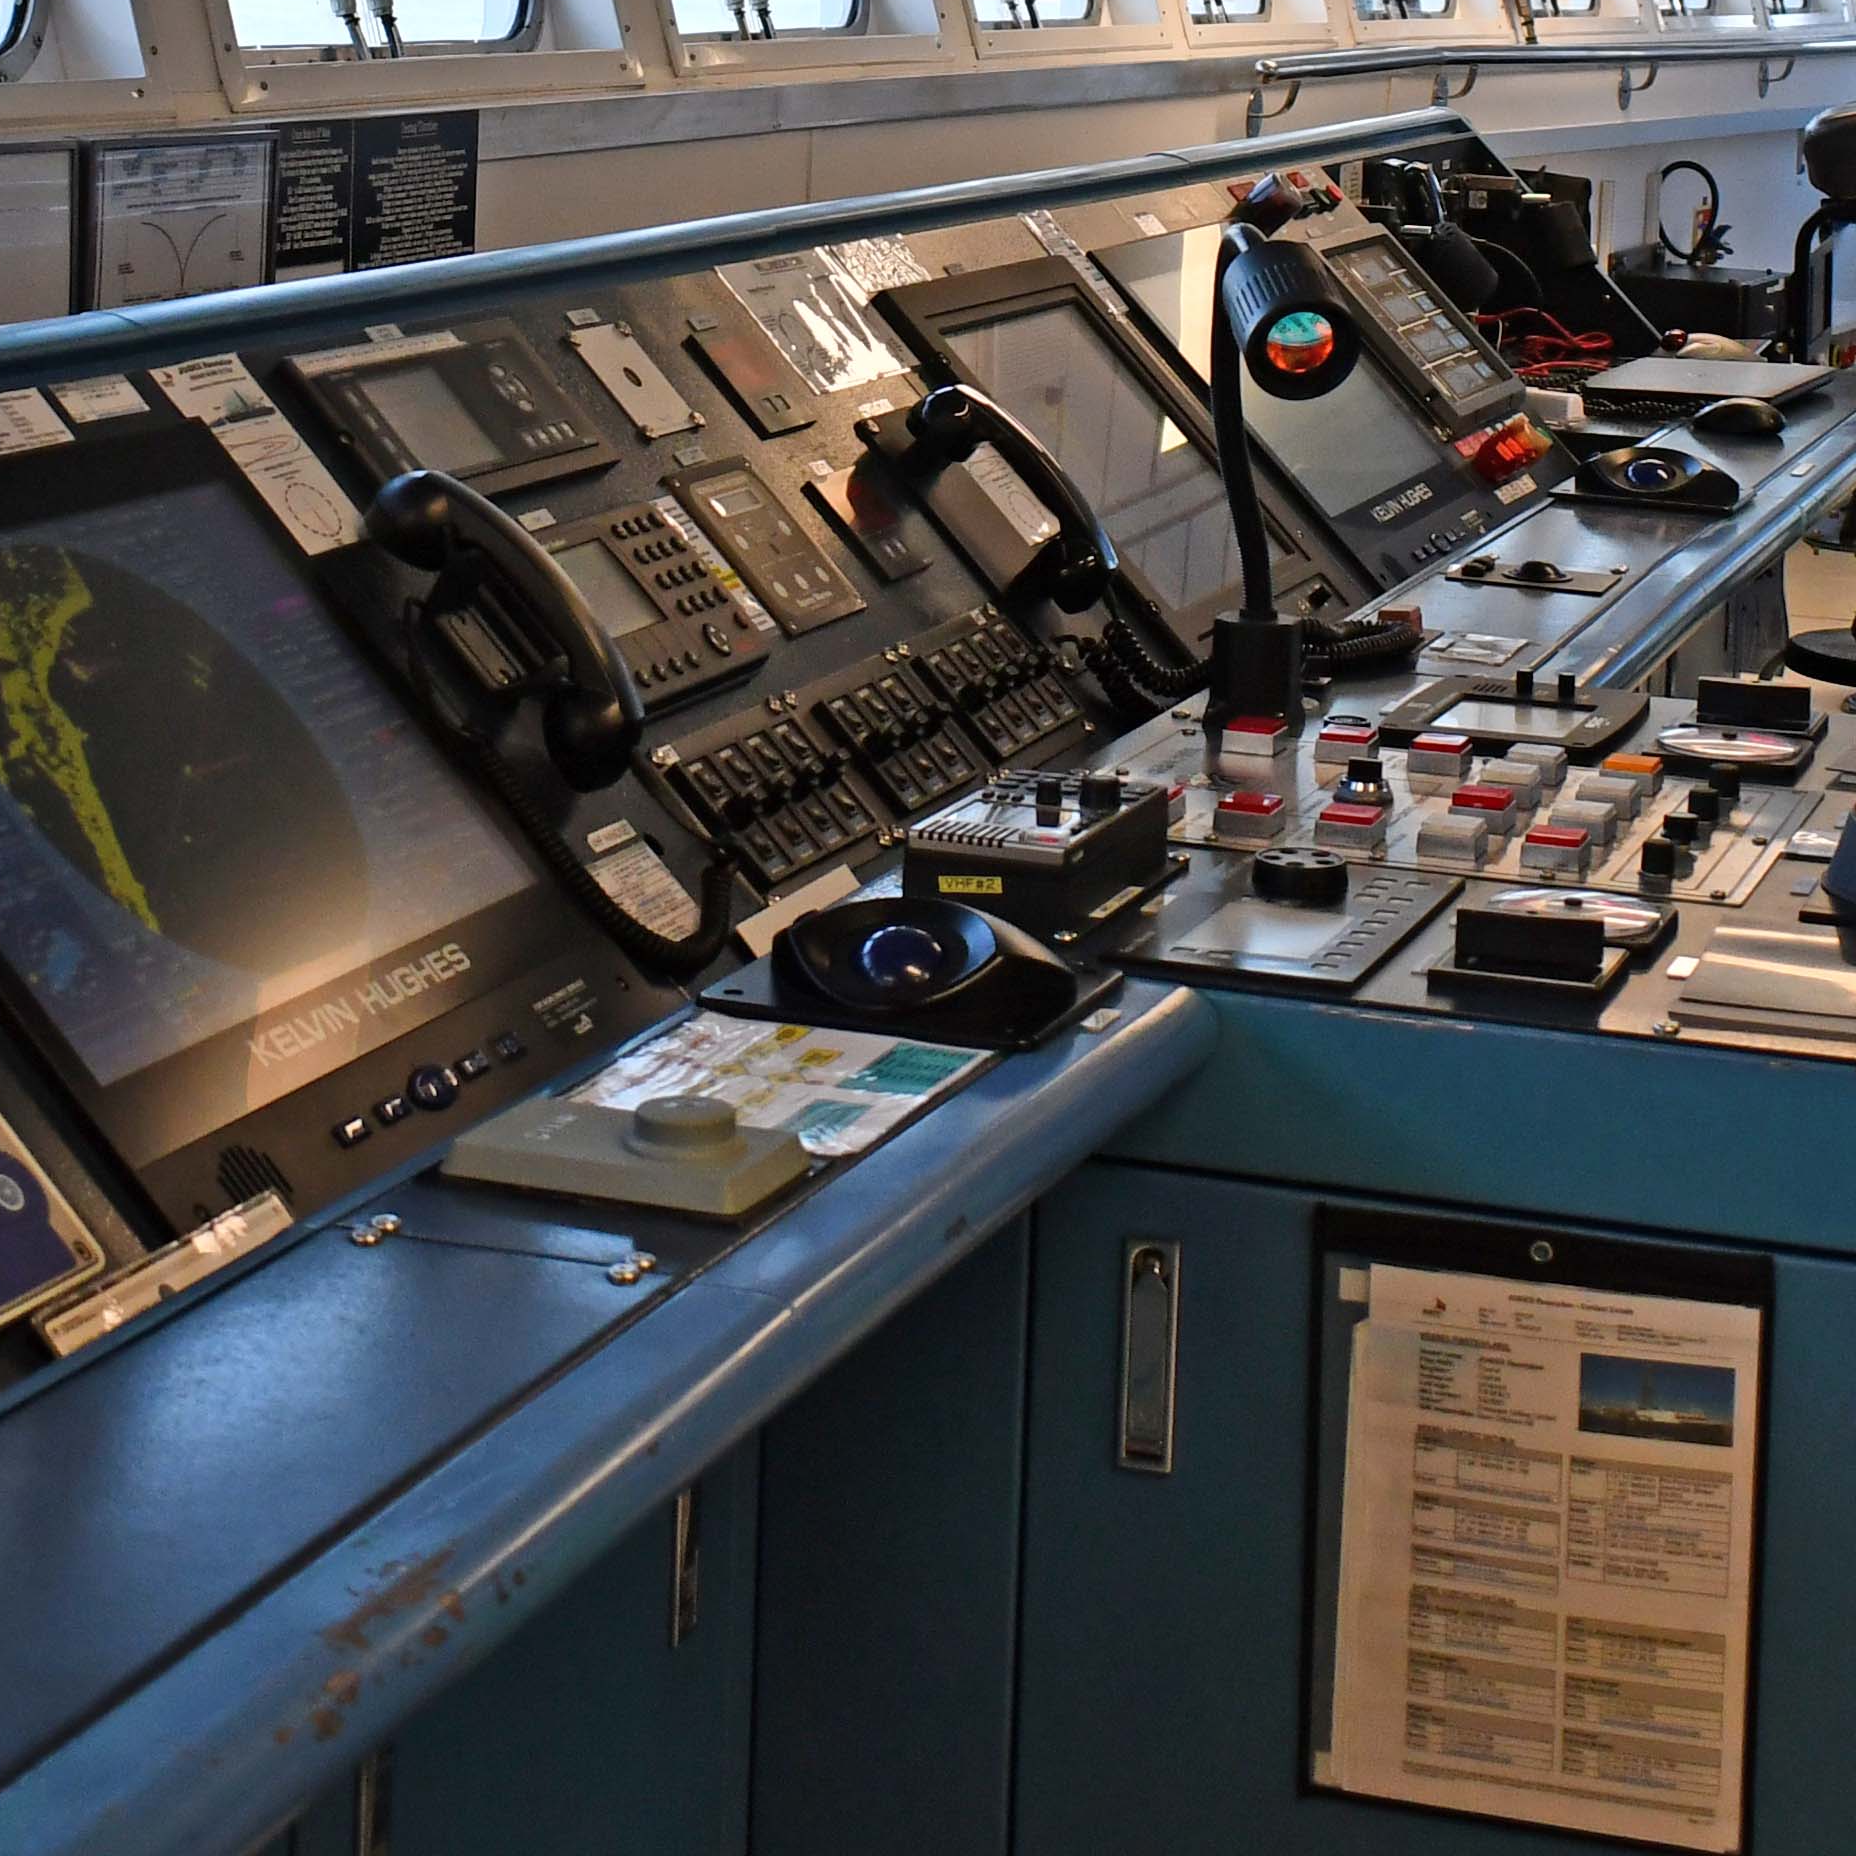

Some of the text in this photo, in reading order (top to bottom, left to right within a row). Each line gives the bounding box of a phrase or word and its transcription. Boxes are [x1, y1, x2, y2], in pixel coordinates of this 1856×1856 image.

[1370, 482, 1434, 524] KELVIN HUGHES
[945, 877, 995, 890] VHF#2
[248, 997, 361, 1067] KELVIN
[354, 943, 471, 1015] HUGHES
